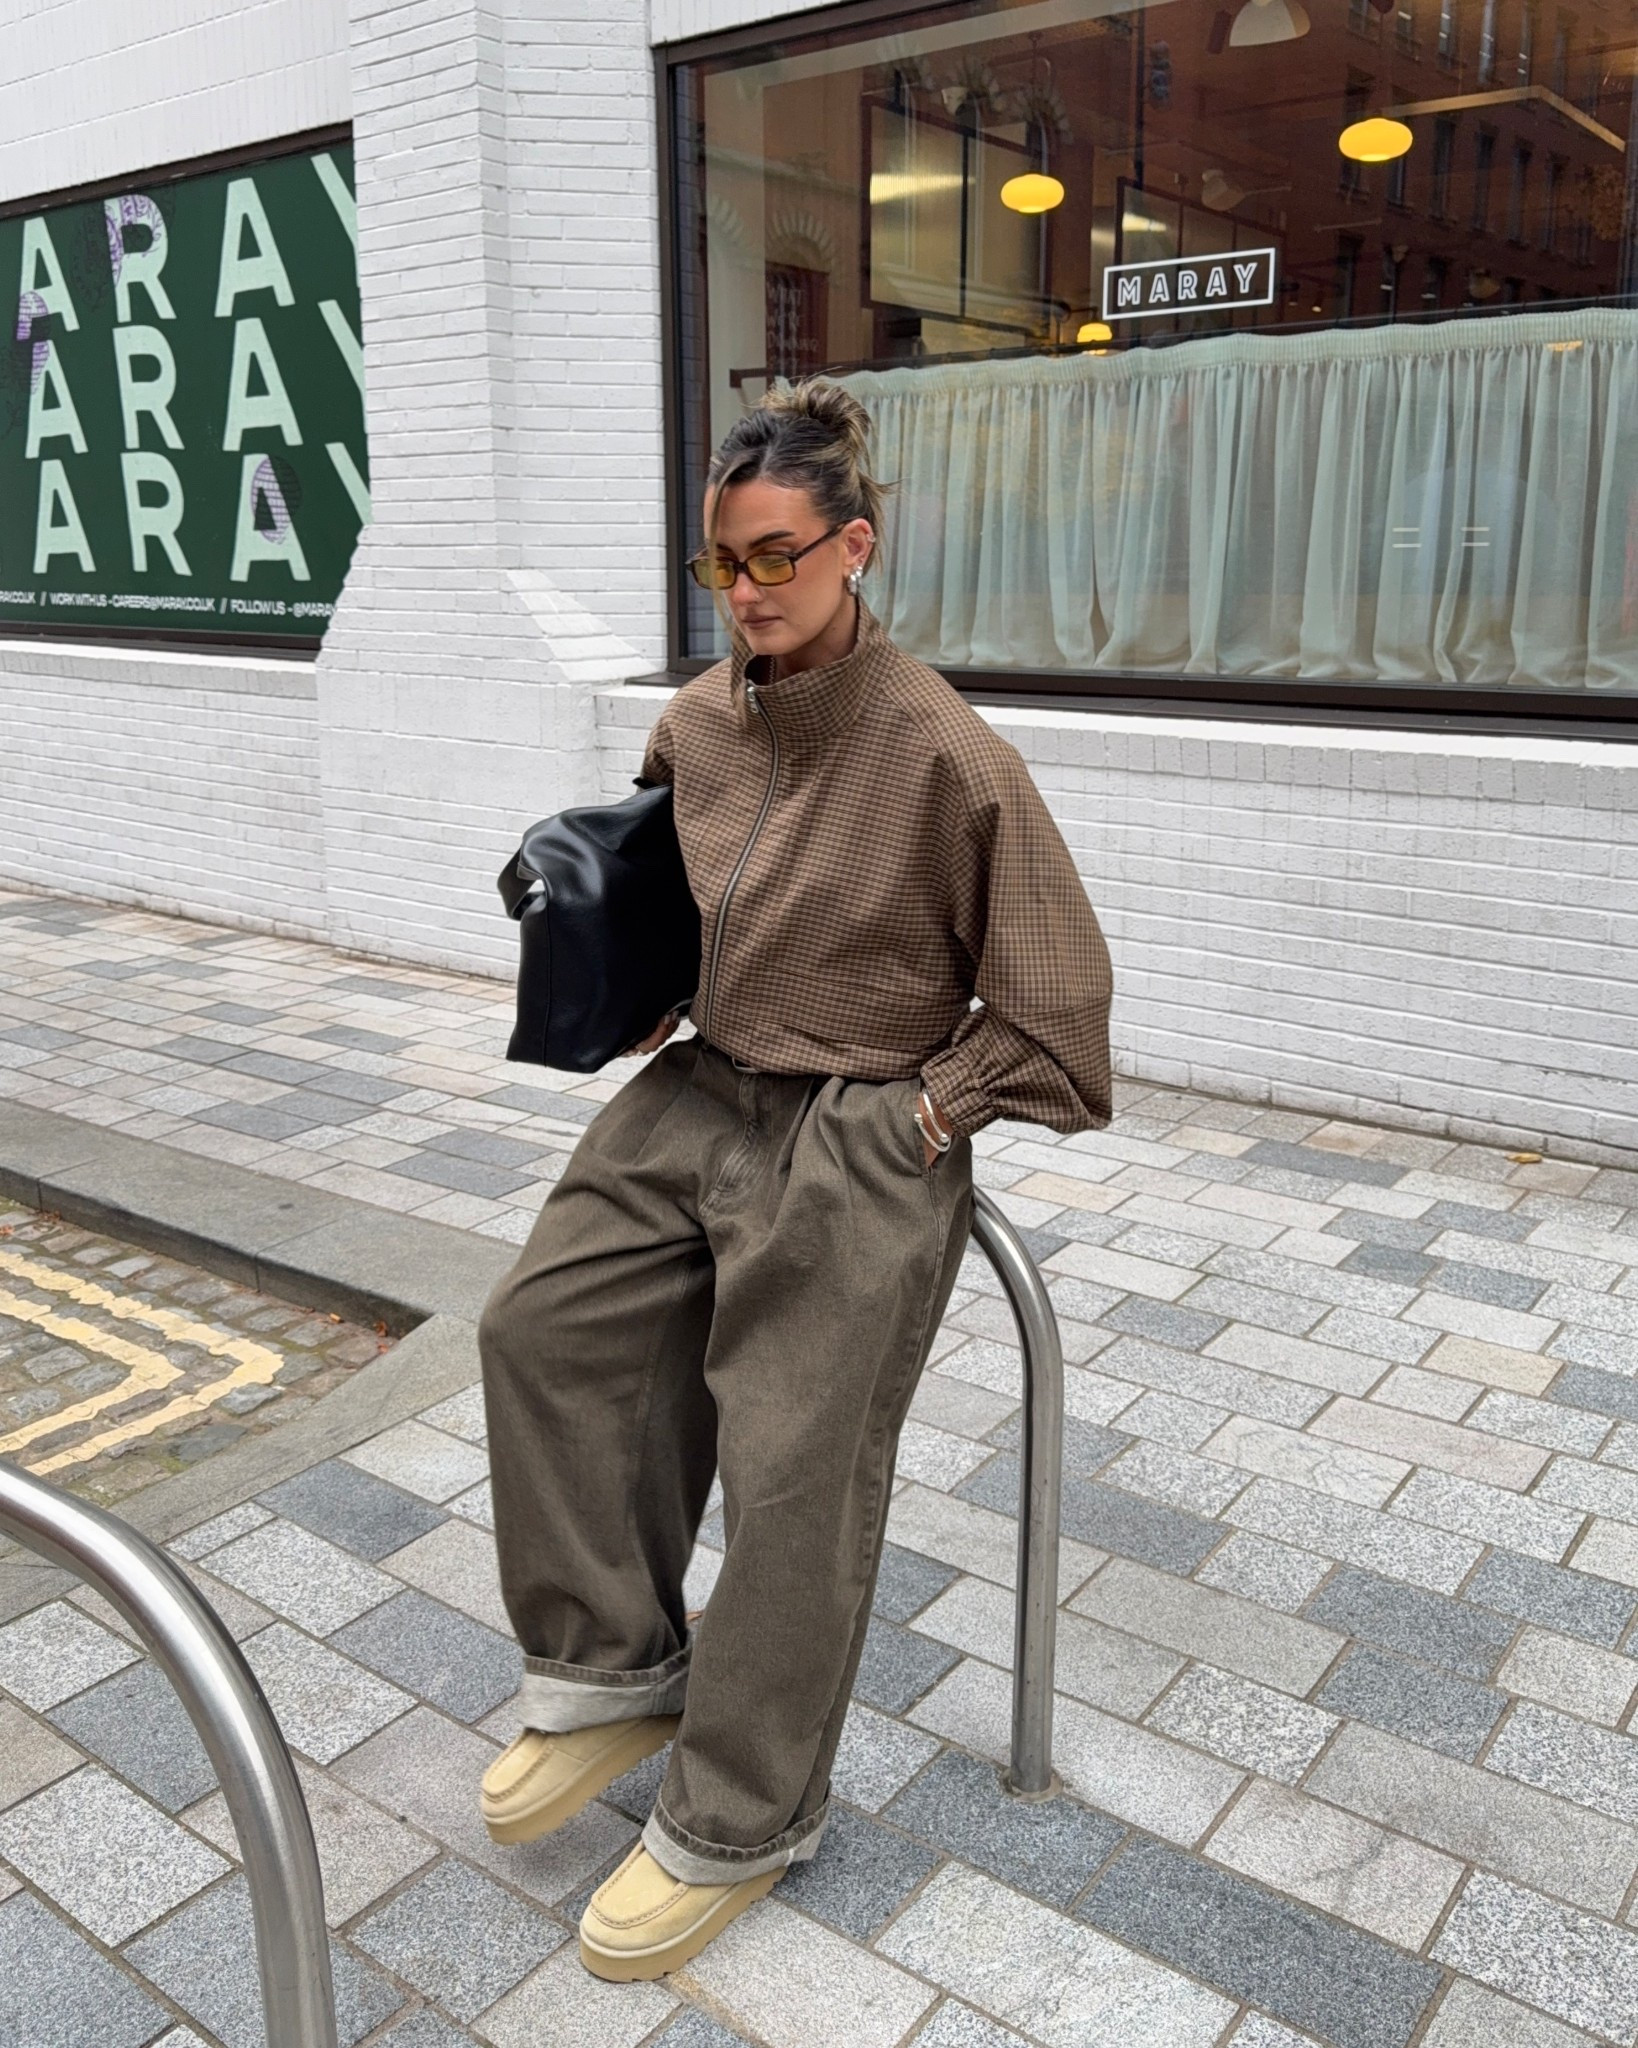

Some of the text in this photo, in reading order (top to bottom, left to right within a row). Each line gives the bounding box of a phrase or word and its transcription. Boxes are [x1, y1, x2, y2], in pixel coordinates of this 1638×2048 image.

[1117, 262, 1258, 307] MARAY
[49, 592, 75, 606] WORK
[75, 593, 96, 607] WITH
[96, 594, 108, 608] US
[230, 599, 271, 615] FOLLOW
[271, 600, 286, 616] US
